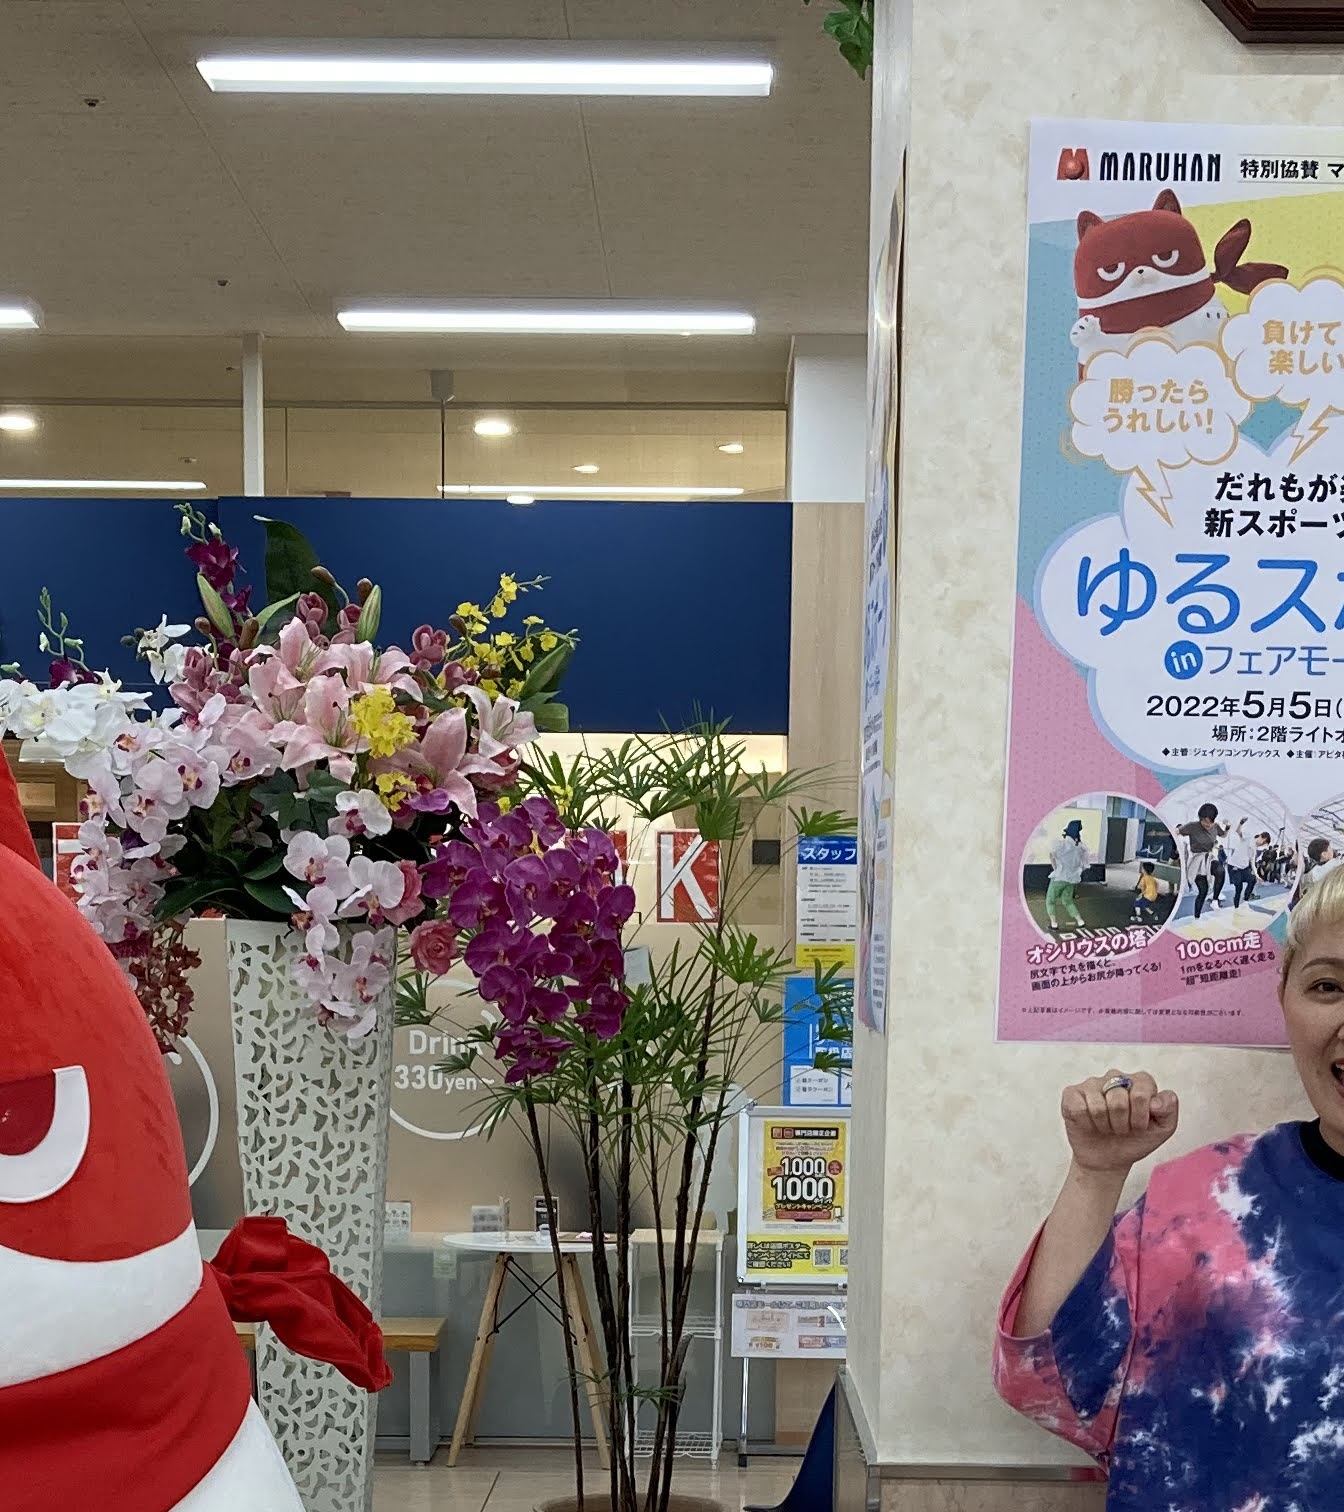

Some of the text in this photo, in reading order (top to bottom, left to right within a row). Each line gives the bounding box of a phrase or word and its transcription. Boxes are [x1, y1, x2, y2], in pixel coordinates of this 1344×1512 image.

[1099, 151, 1221, 182] MARUHAN
[1240, 159, 1319, 180] 特別協賛
[1108, 377, 1210, 405] 勝ったら
[1102, 407, 1214, 435] うれしい!
[1170, 643, 1199, 676] in
[1026, 928, 1150, 966] オシリウスの塔
[1175, 930, 1263, 961] 100cm走
